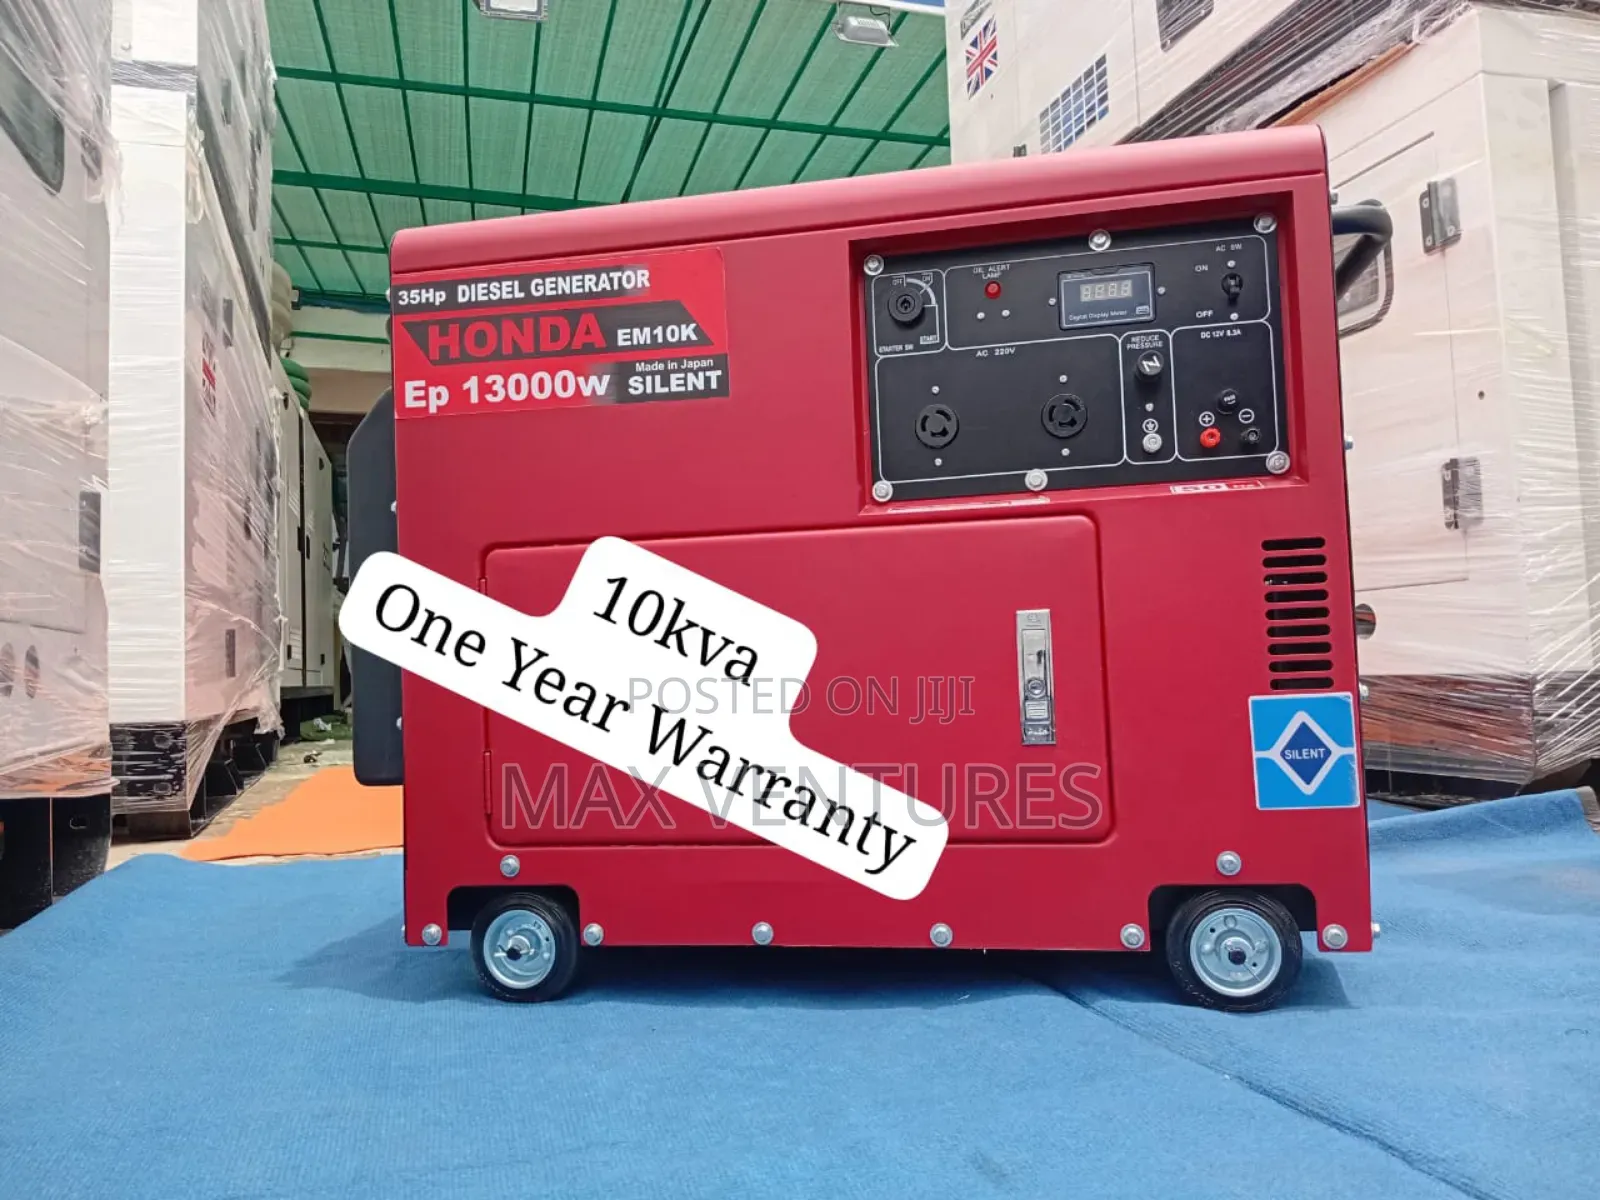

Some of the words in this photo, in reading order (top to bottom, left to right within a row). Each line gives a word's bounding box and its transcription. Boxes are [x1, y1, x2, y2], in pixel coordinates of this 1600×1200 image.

[1194, 264, 1208, 272] ON
[398, 288, 446, 306] 35Hp
[457, 279, 525, 303] DIESEL
[529, 269, 651, 297] GENERATOR
[1195, 309, 1213, 318] OFF
[428, 312, 607, 361] HONDA
[616, 323, 699, 347] EM10K
[1200, 331, 1211, 339] DC
[975, 349, 989, 357] AC
[994, 347, 1016, 356] 220V
[635, 361, 665, 372] Made
[667, 359, 678, 370] in
[680, 358, 714, 372] Japan
[628, 370, 722, 395] SILENT
[404, 380, 450, 413] Ep
[461, 369, 611, 405] 13000w
[1284, 748, 1326, 760] SILENT
